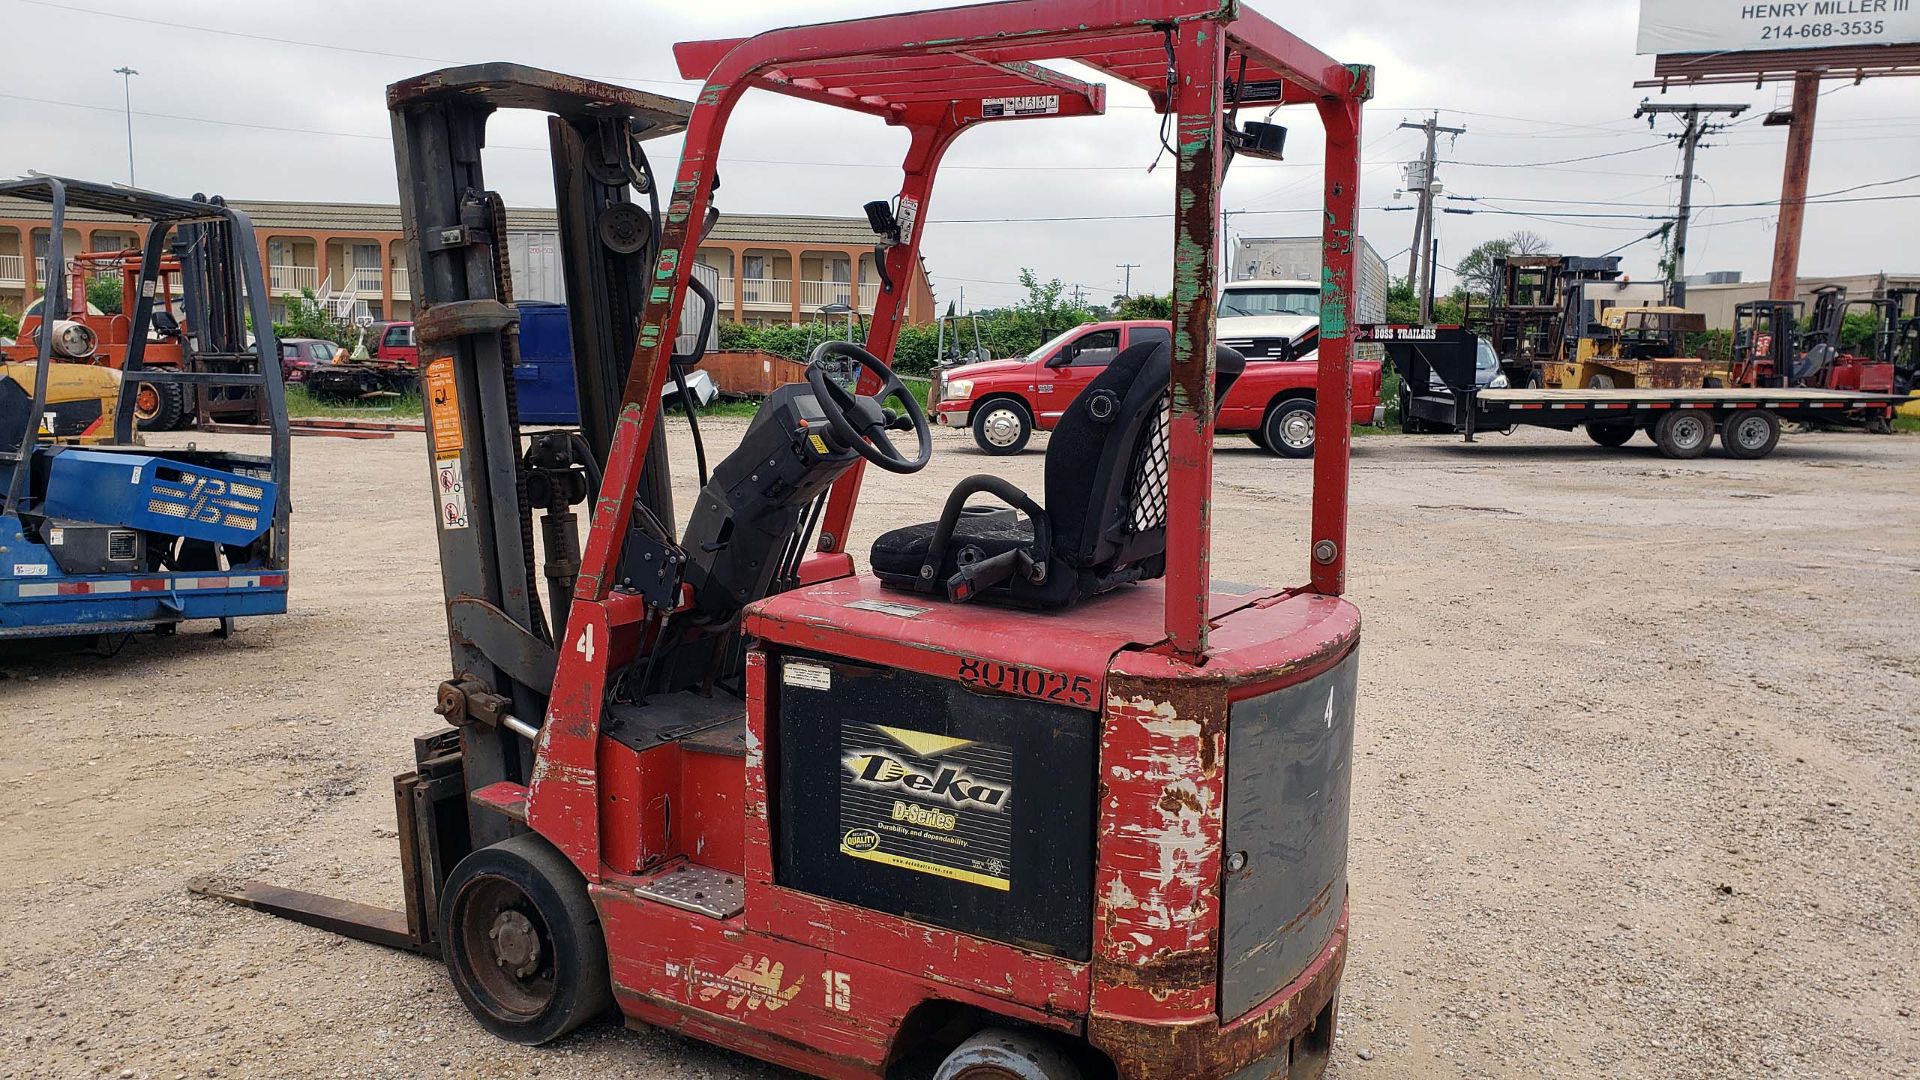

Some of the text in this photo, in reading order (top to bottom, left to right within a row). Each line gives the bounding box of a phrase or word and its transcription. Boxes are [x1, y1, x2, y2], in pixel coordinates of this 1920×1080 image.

[1741, 0, 1909, 19] HENRY MILLER III
[1761, 20, 1884, 40] 214-668-3535
[1375, 328, 1393, 339] BOSS
[1397, 328, 1436, 340] TRAILERS
[577, 623, 595, 662] 4
[959, 658, 1092, 705] 801025
[1323, 685, 1334, 729] 4
[858, 753, 1005, 806] Deka
[892, 801, 956, 831] D-Series
[847, 836, 875, 845] QUALITY
[821, 969, 851, 1012] 15
